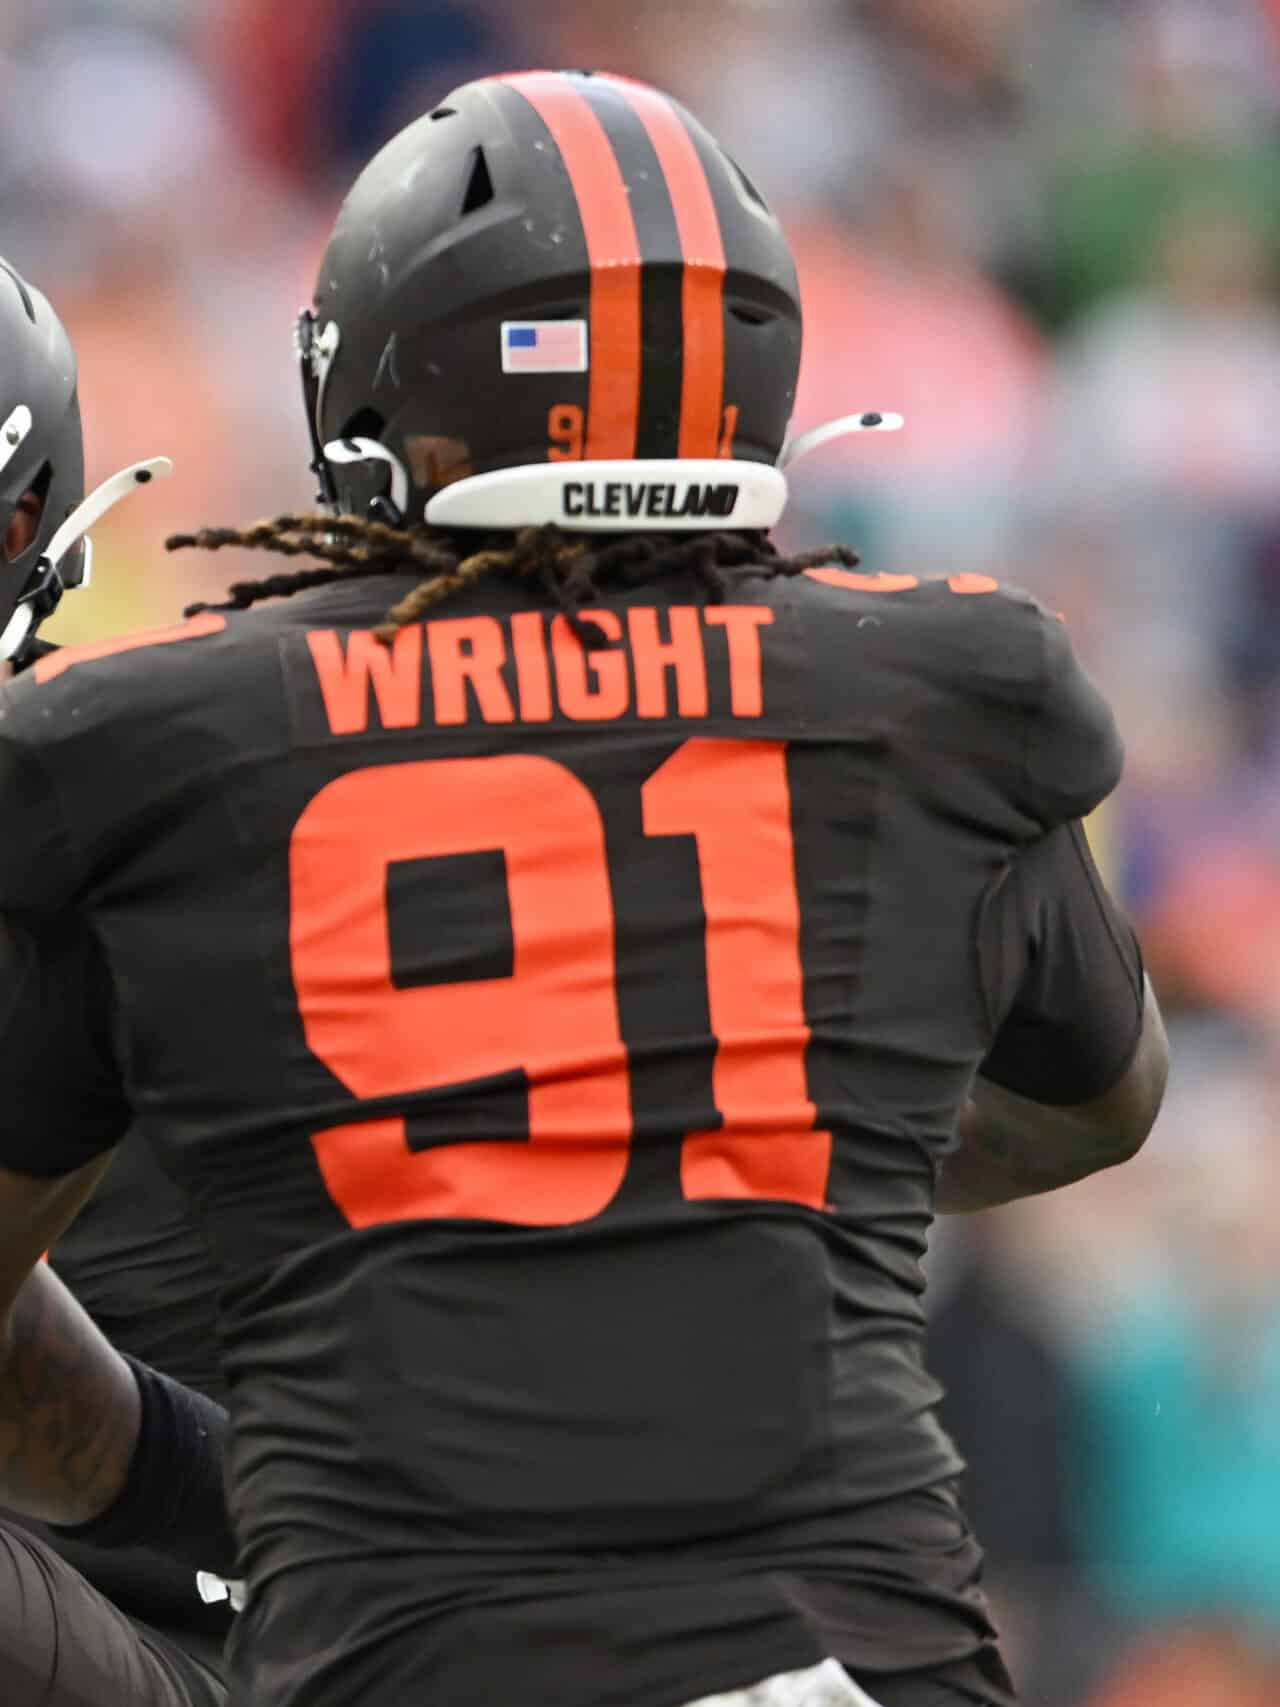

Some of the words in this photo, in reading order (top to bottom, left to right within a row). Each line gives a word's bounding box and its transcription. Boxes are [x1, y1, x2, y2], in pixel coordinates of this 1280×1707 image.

[548, 405, 583, 462] 9
[563, 482, 739, 517] CLEVELAND
[305, 604, 774, 736] WRIGHT
[289, 736, 833, 1230] 91
